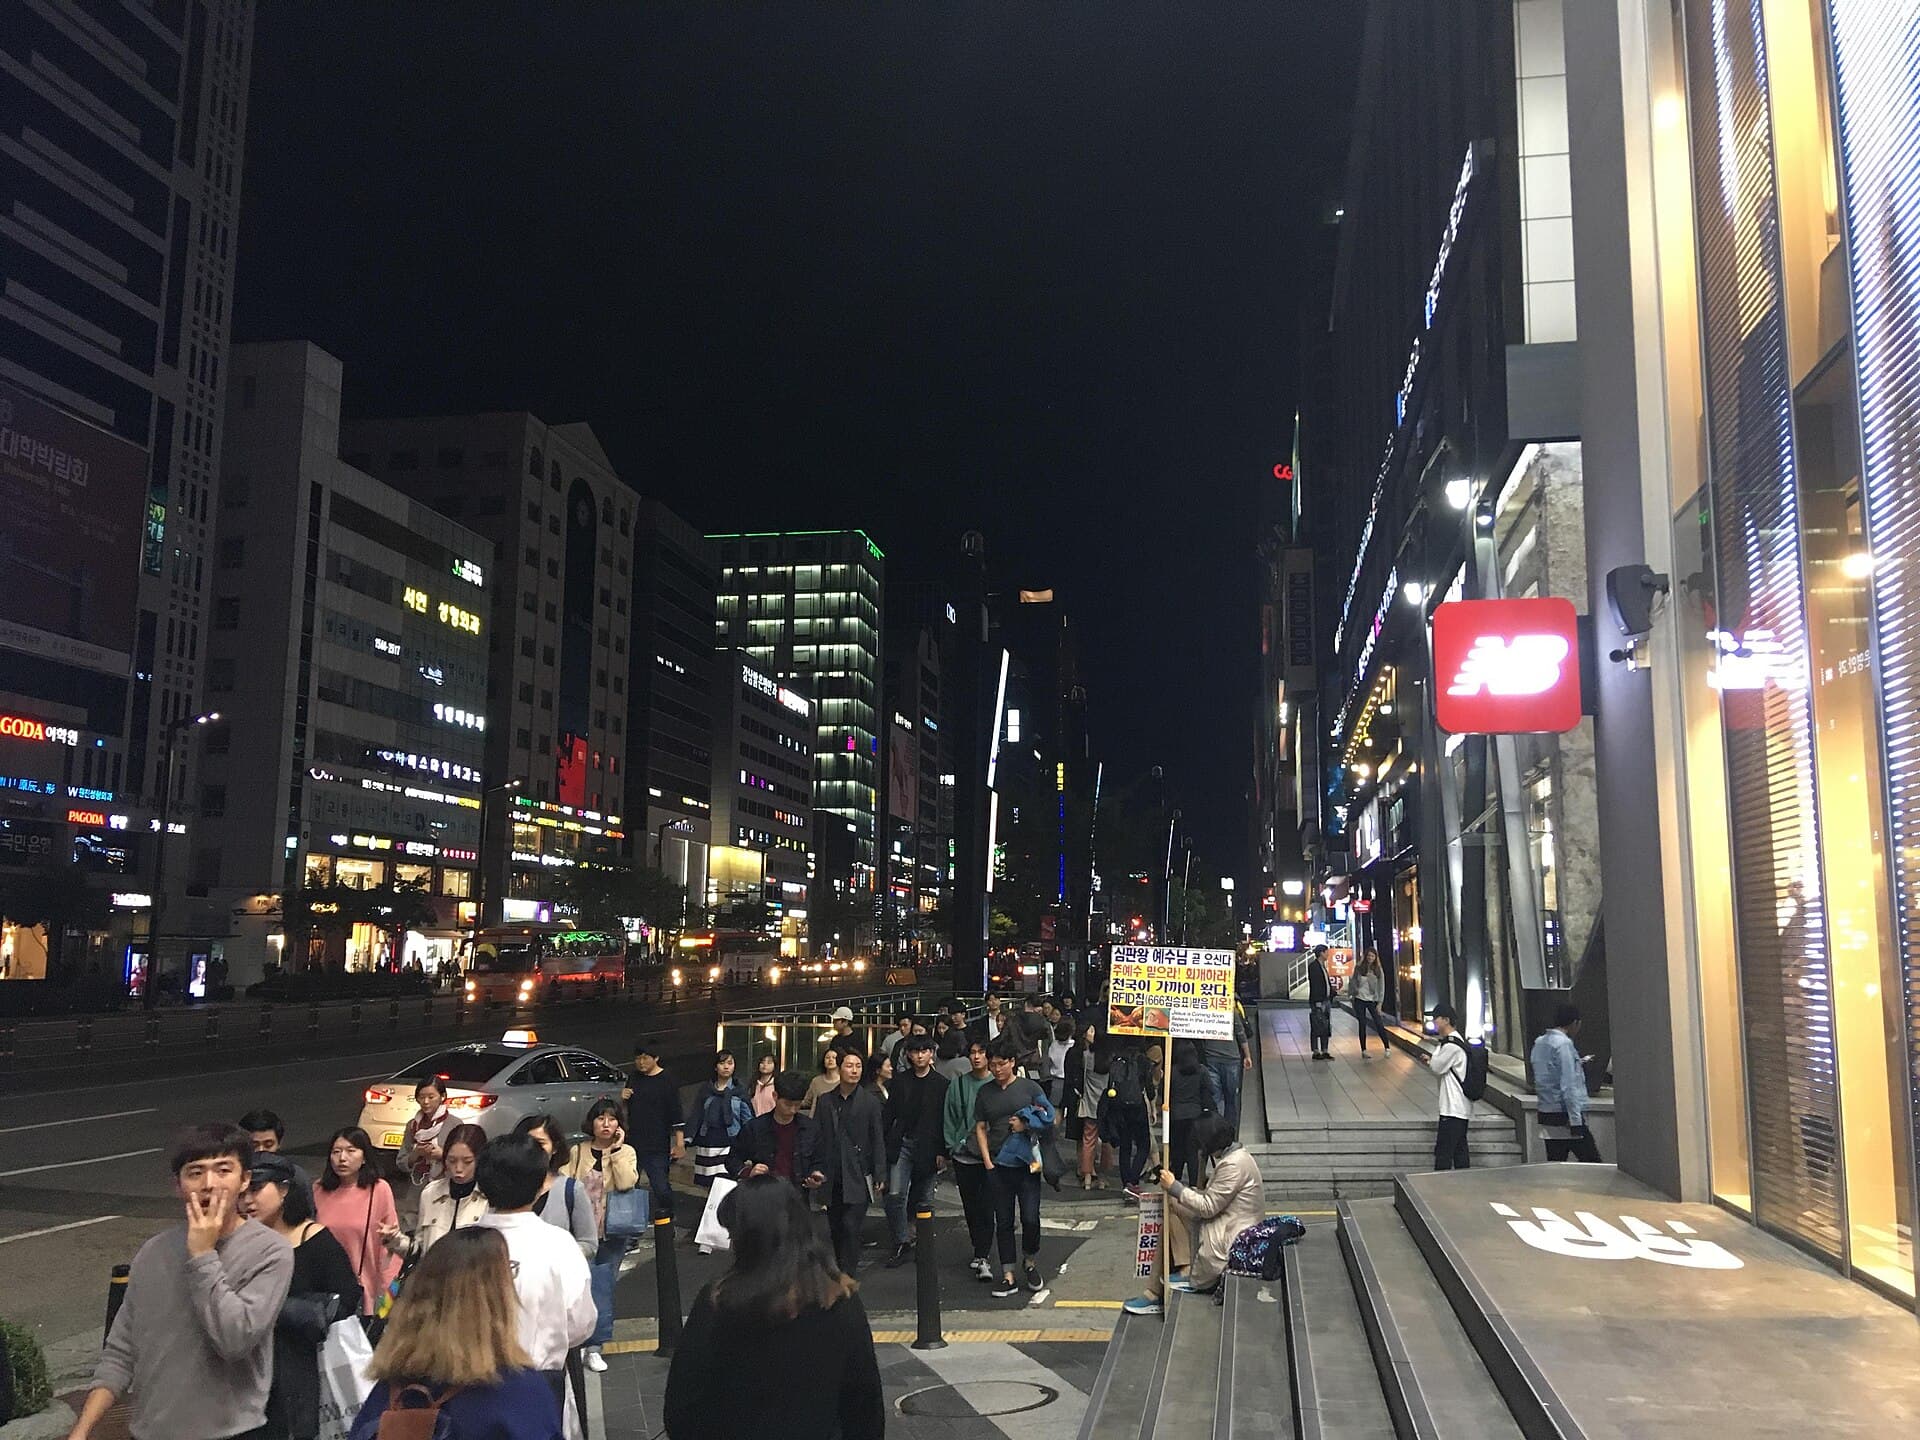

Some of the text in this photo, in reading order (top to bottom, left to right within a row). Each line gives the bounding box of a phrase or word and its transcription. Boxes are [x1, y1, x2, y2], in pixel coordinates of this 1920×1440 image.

[0, 427, 89, 487] 대학박람회
[438, 602, 480, 635] 성형외과
[45, 726, 78, 747] 어학원
[69, 811, 104, 825] PAGODA
[1114, 947, 1232, 966] 심판왕 예수님 곧 오신다
[1112, 964, 1142, 978] 주예수
[1146, 965, 1181, 980] 믿으라!
[1112, 977, 1231, 997] 천국이 가까이 왔다.
